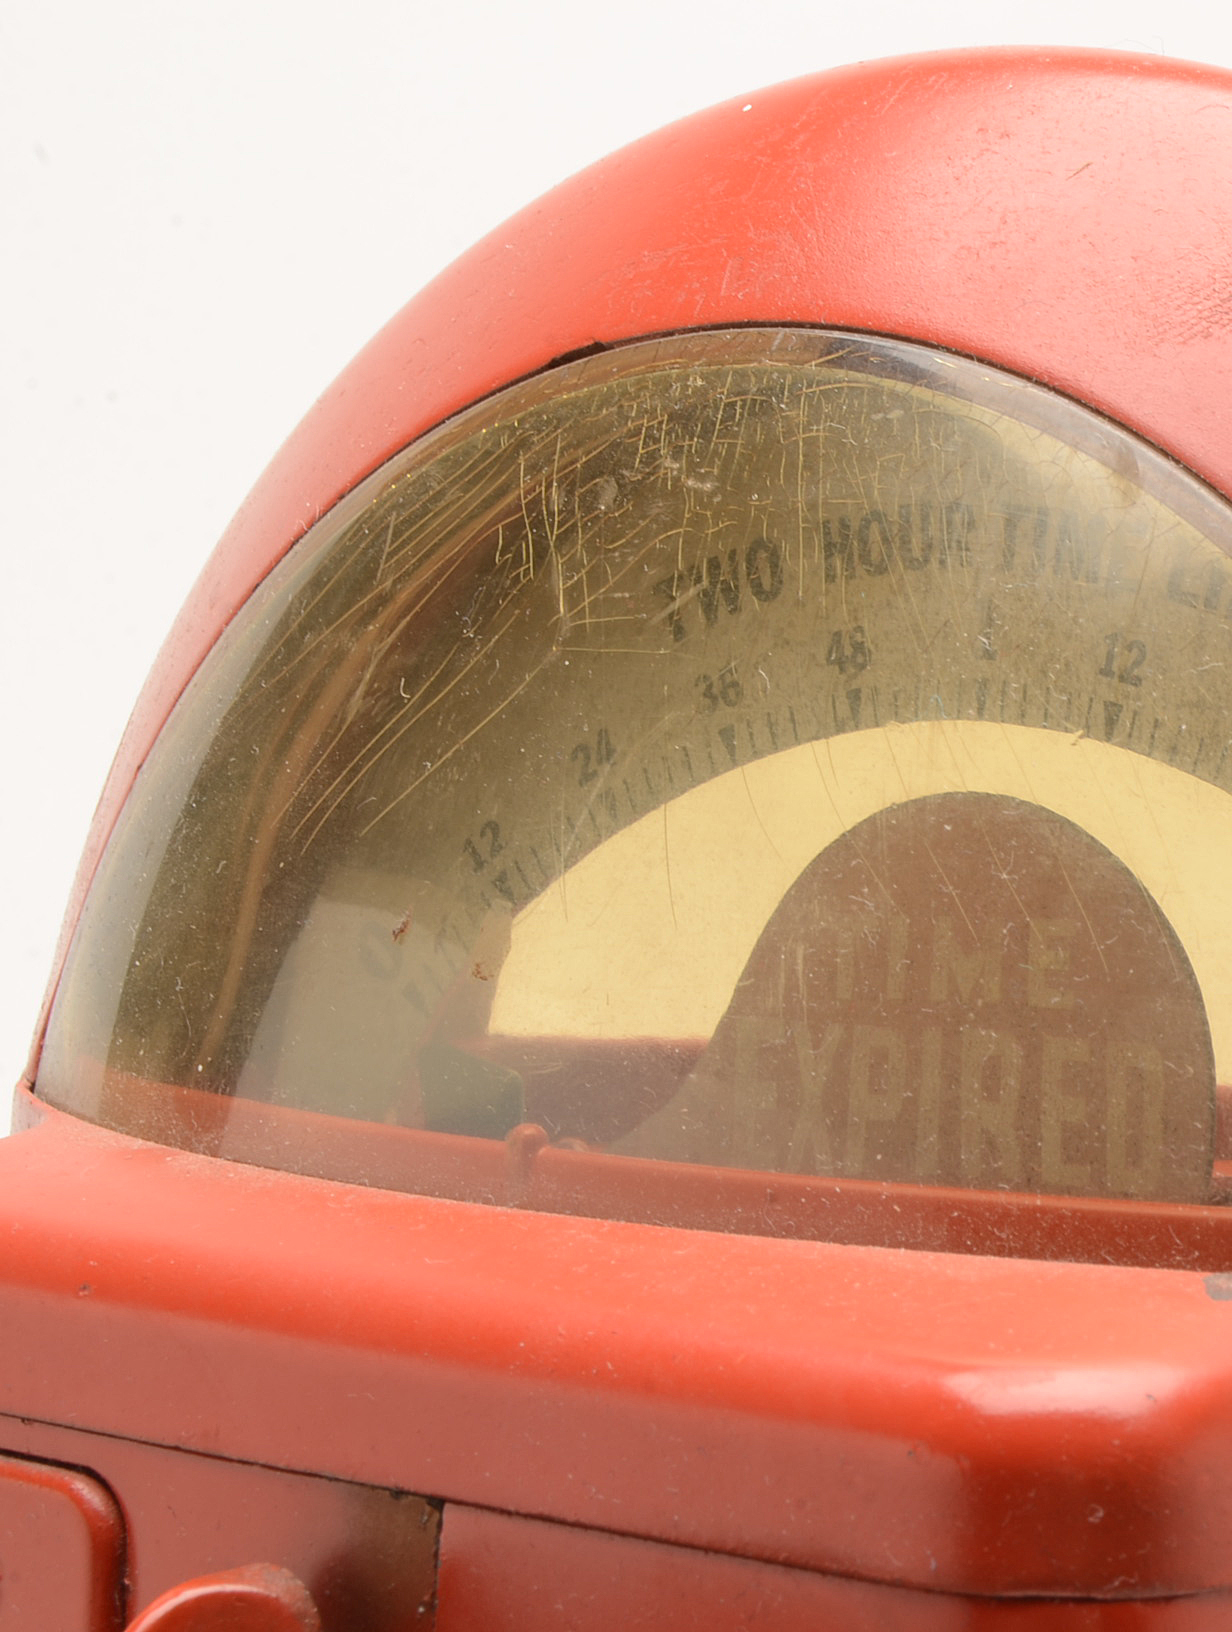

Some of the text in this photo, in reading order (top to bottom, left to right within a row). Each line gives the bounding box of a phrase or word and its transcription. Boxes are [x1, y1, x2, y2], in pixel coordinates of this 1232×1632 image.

[652, 537, 783, 642] TWO
[823, 502, 976, 585] HOUR
[463, 820, 506, 873] 12
[570, 728, 617, 787] 24
[694, 664, 744, 714] 36
[825, 625, 872, 675] 48
[1100, 631, 1148, 688] 12
[816, 913, 1078, 1009] TIME
[733, 1015, 1166, 1193] EXPIRED
